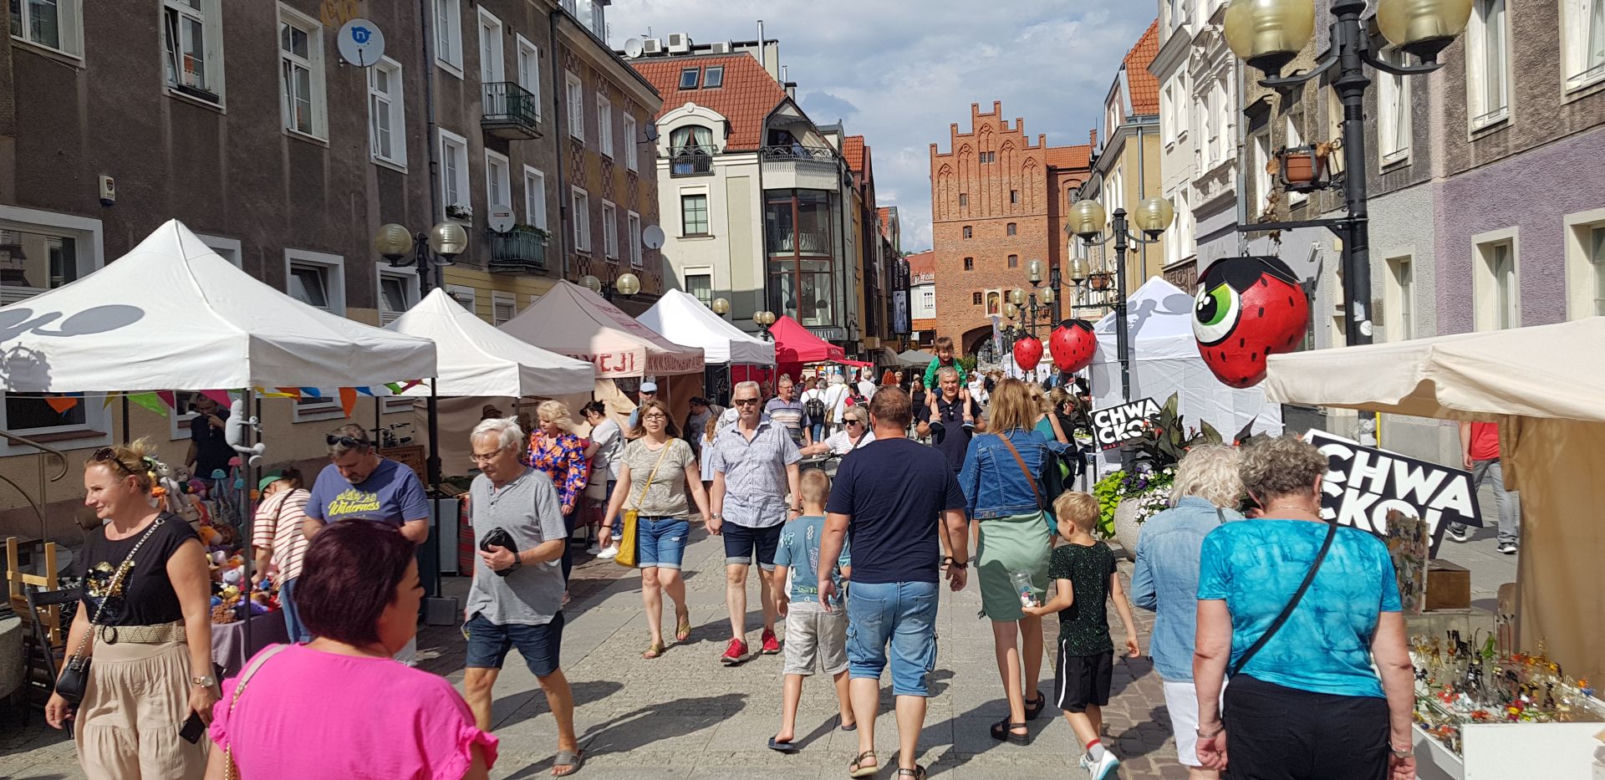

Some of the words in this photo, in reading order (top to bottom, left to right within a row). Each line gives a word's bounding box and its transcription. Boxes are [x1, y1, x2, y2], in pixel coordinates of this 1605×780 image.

[1094, 399, 1162, 428] CHWA
[1317, 443, 1475, 518] CHWA
[328, 500, 380, 516] Wilderness
